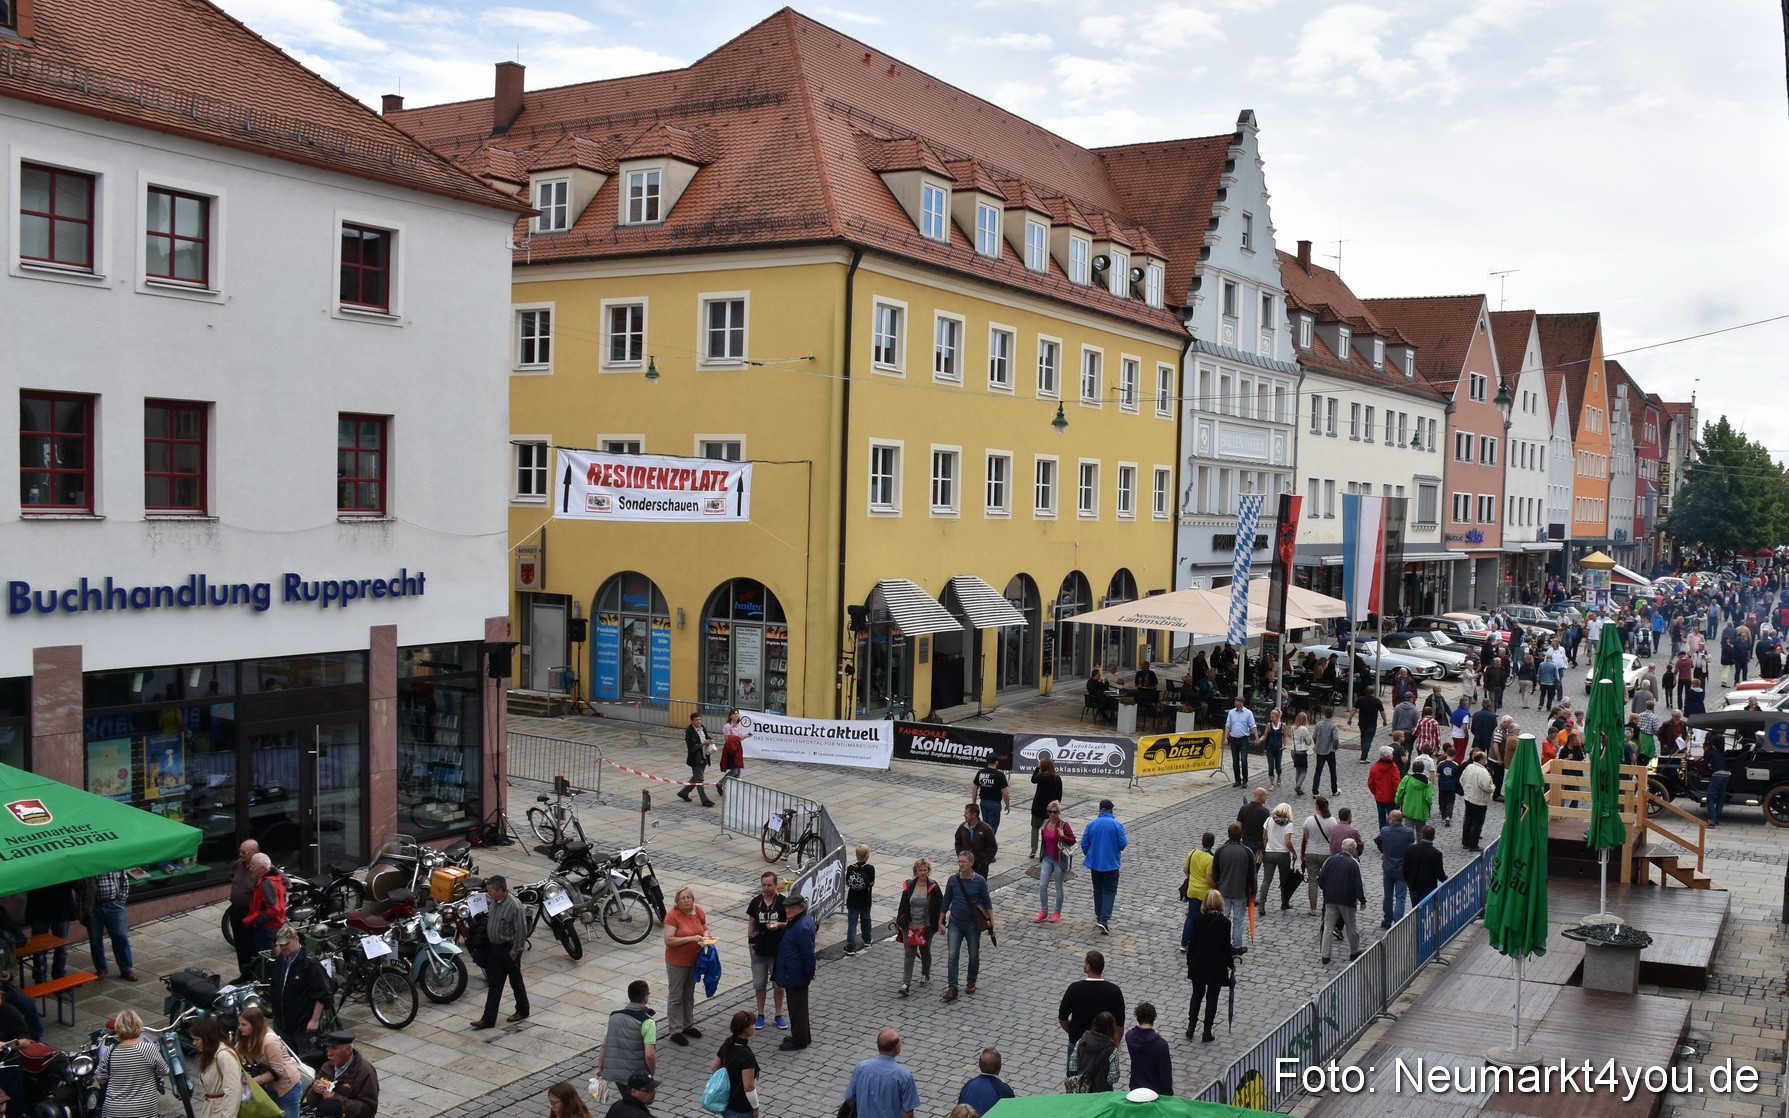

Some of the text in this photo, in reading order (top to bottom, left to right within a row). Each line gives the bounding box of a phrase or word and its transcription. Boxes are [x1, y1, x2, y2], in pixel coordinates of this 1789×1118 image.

[587, 463, 729, 492] RESIDENZPLATZ
[1659, 463, 1670, 517] HOTEL
[618, 495, 699, 512] Sonderschauen
[9, 568, 426, 614] Buchhandlung Rupprecht
[735, 601, 763, 611] hailer
[899, 727, 948, 739] FAHRSCHULE
[765, 736, 823, 746] NACHRICHTENPORTAL
[1057, 748, 1104, 761] Dietz
[1168, 745, 1202, 758] Dietz
[1020, 765, 1125, 775] wwwoklassik-dietz.de
[1142, 760, 1216, 773] www.autoklassik-dietz.de
[4, 824, 92, 846] Neumarkter
[0, 831, 119, 862] Lammsbräu
